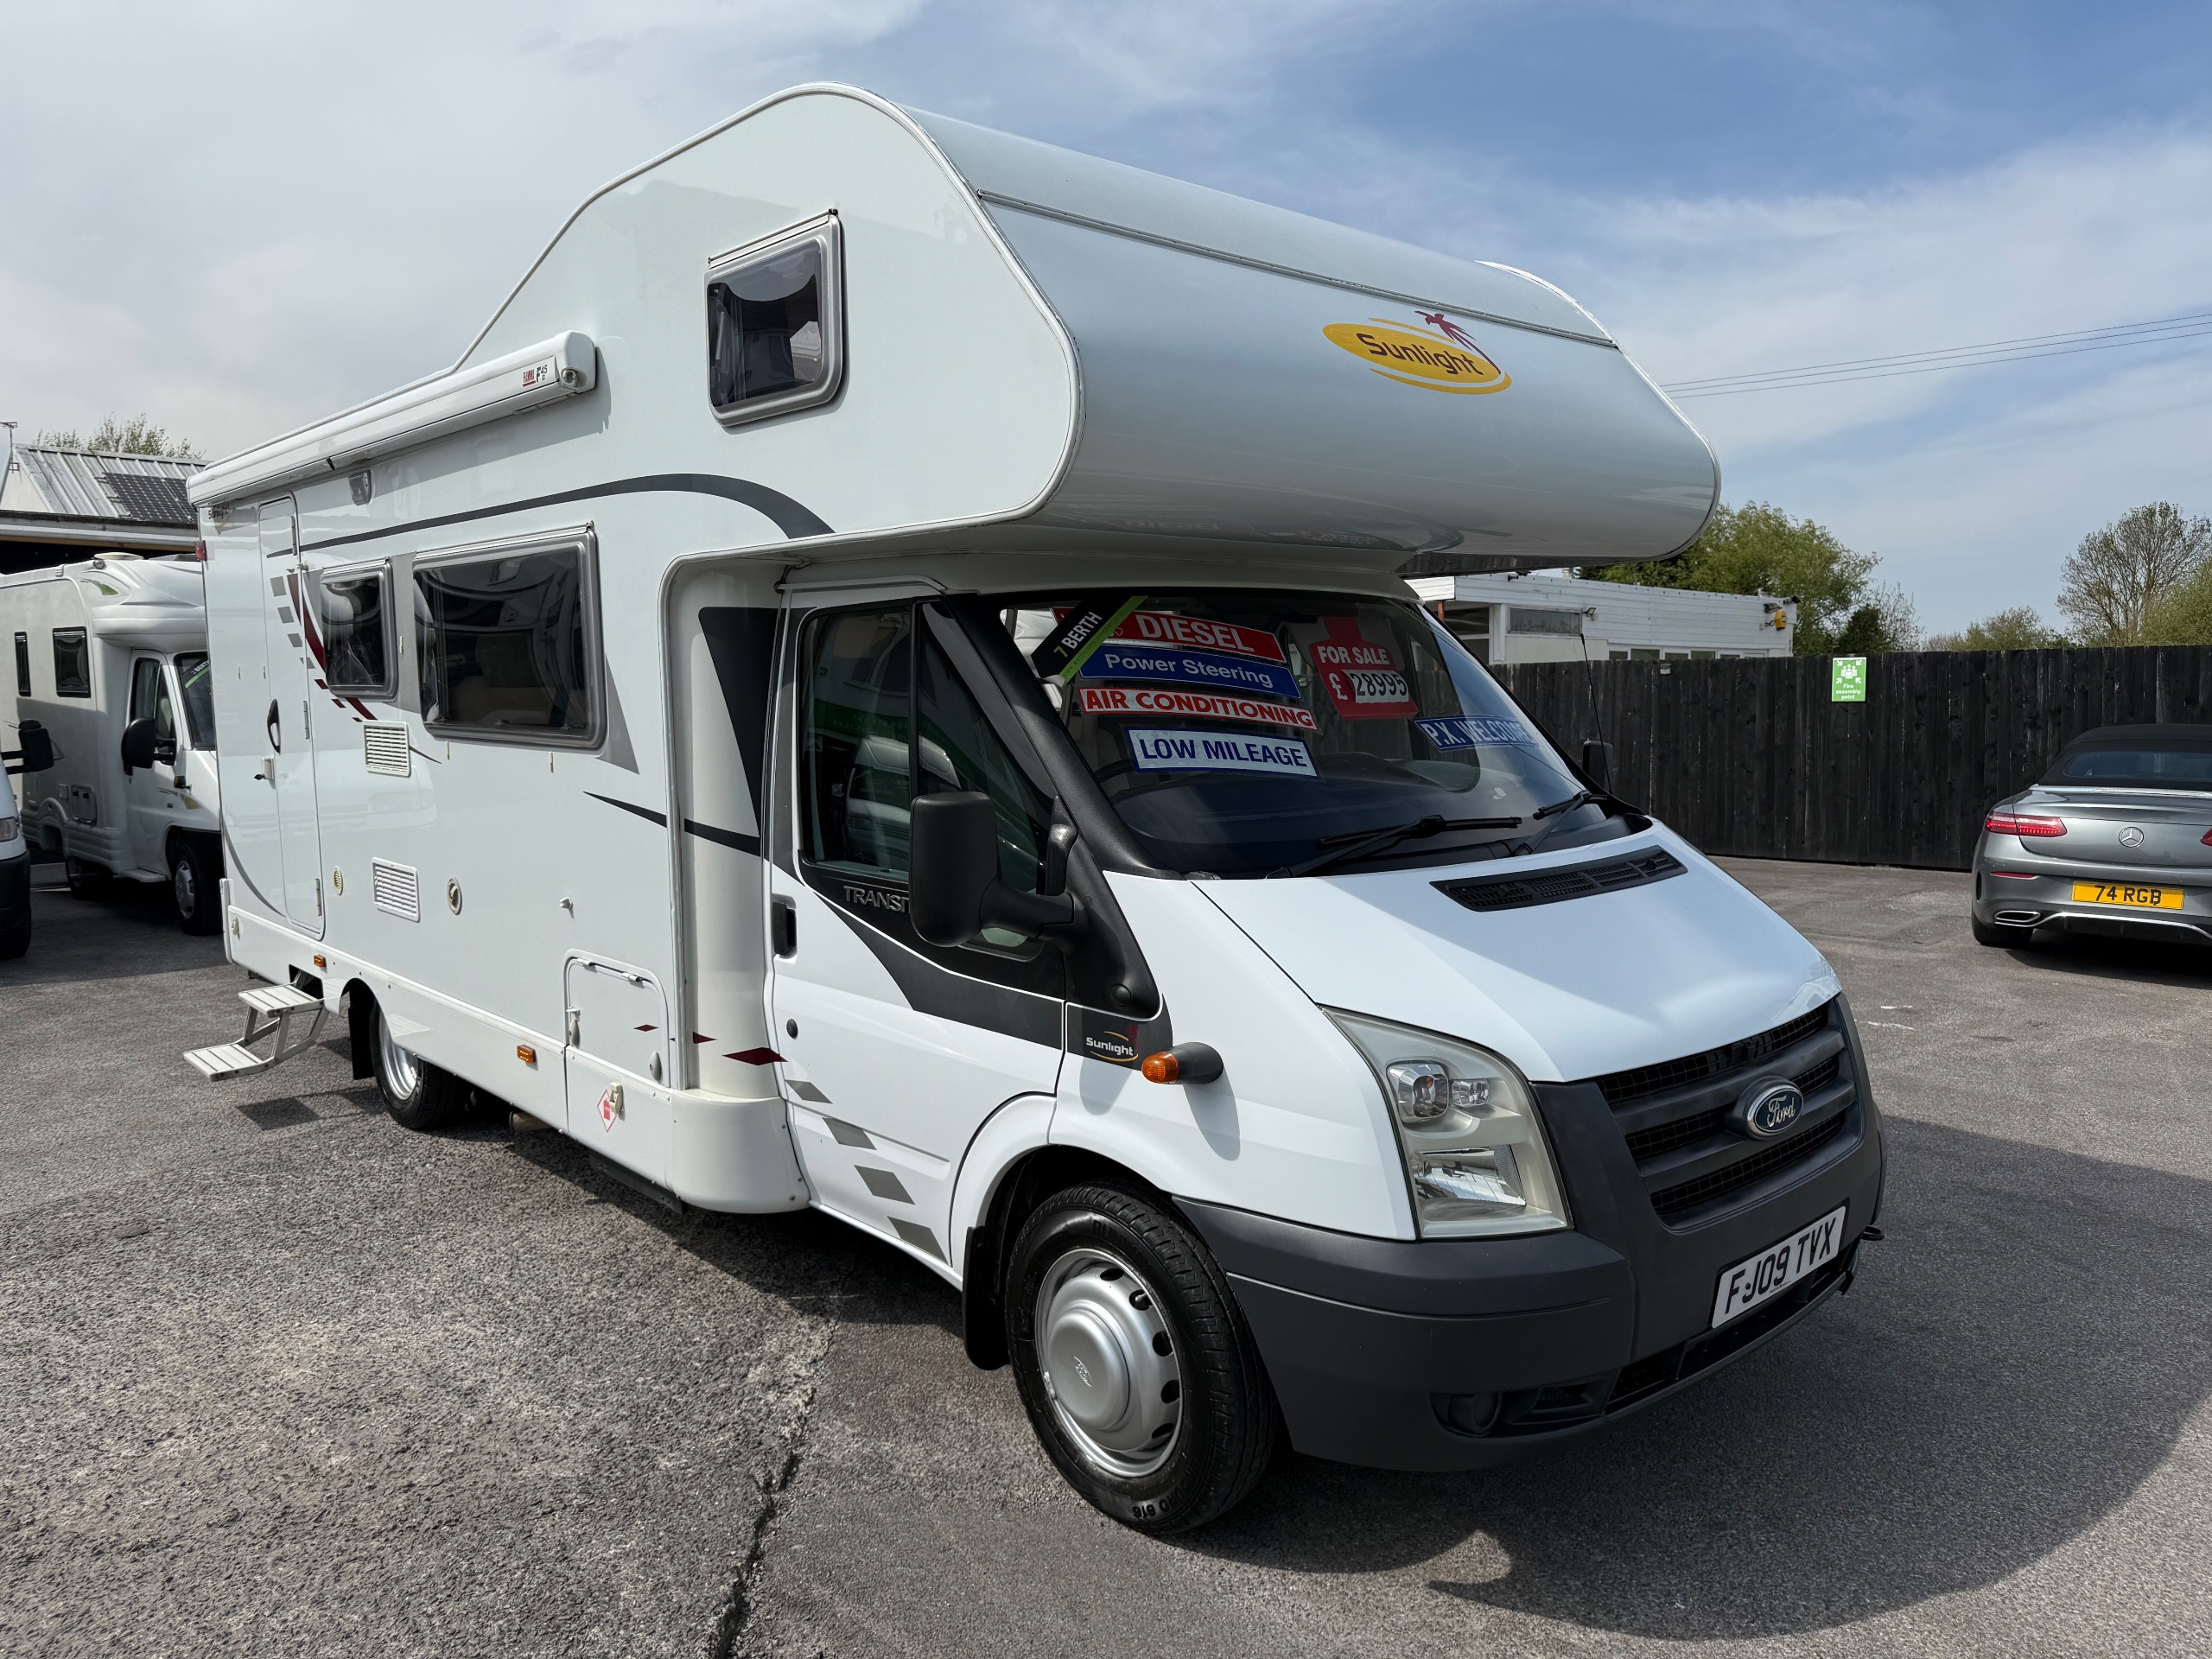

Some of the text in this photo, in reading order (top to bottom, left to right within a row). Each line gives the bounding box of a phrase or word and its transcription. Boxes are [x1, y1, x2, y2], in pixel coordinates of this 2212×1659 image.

[1356, 333, 1484, 376] Sunlight
[537, 365, 548, 382] F45
[1052, 611, 1103, 658] 7 BERTH
[1135, 614, 1255, 652] DIESEL
[1317, 646, 1391, 665] FOR SALE
[1104, 653, 1274, 689] Power Steering
[1329, 671, 1408, 701] £ 28995
[1086, 690, 1315, 727] AIR CONDITIONING
[1421, 719, 1538, 747] P.X. WELCOME
[1139, 738, 1308, 767] LOW MILEAGE
[843, 885, 910, 913] TRANSI
[2094, 885, 2162, 905] 74 RGB
[1085, 1037, 1134, 1057] Sunlight
[1766, 1095, 1796, 1128] Ford
[1725, 1217, 1837, 1315] FJ09 TVX
